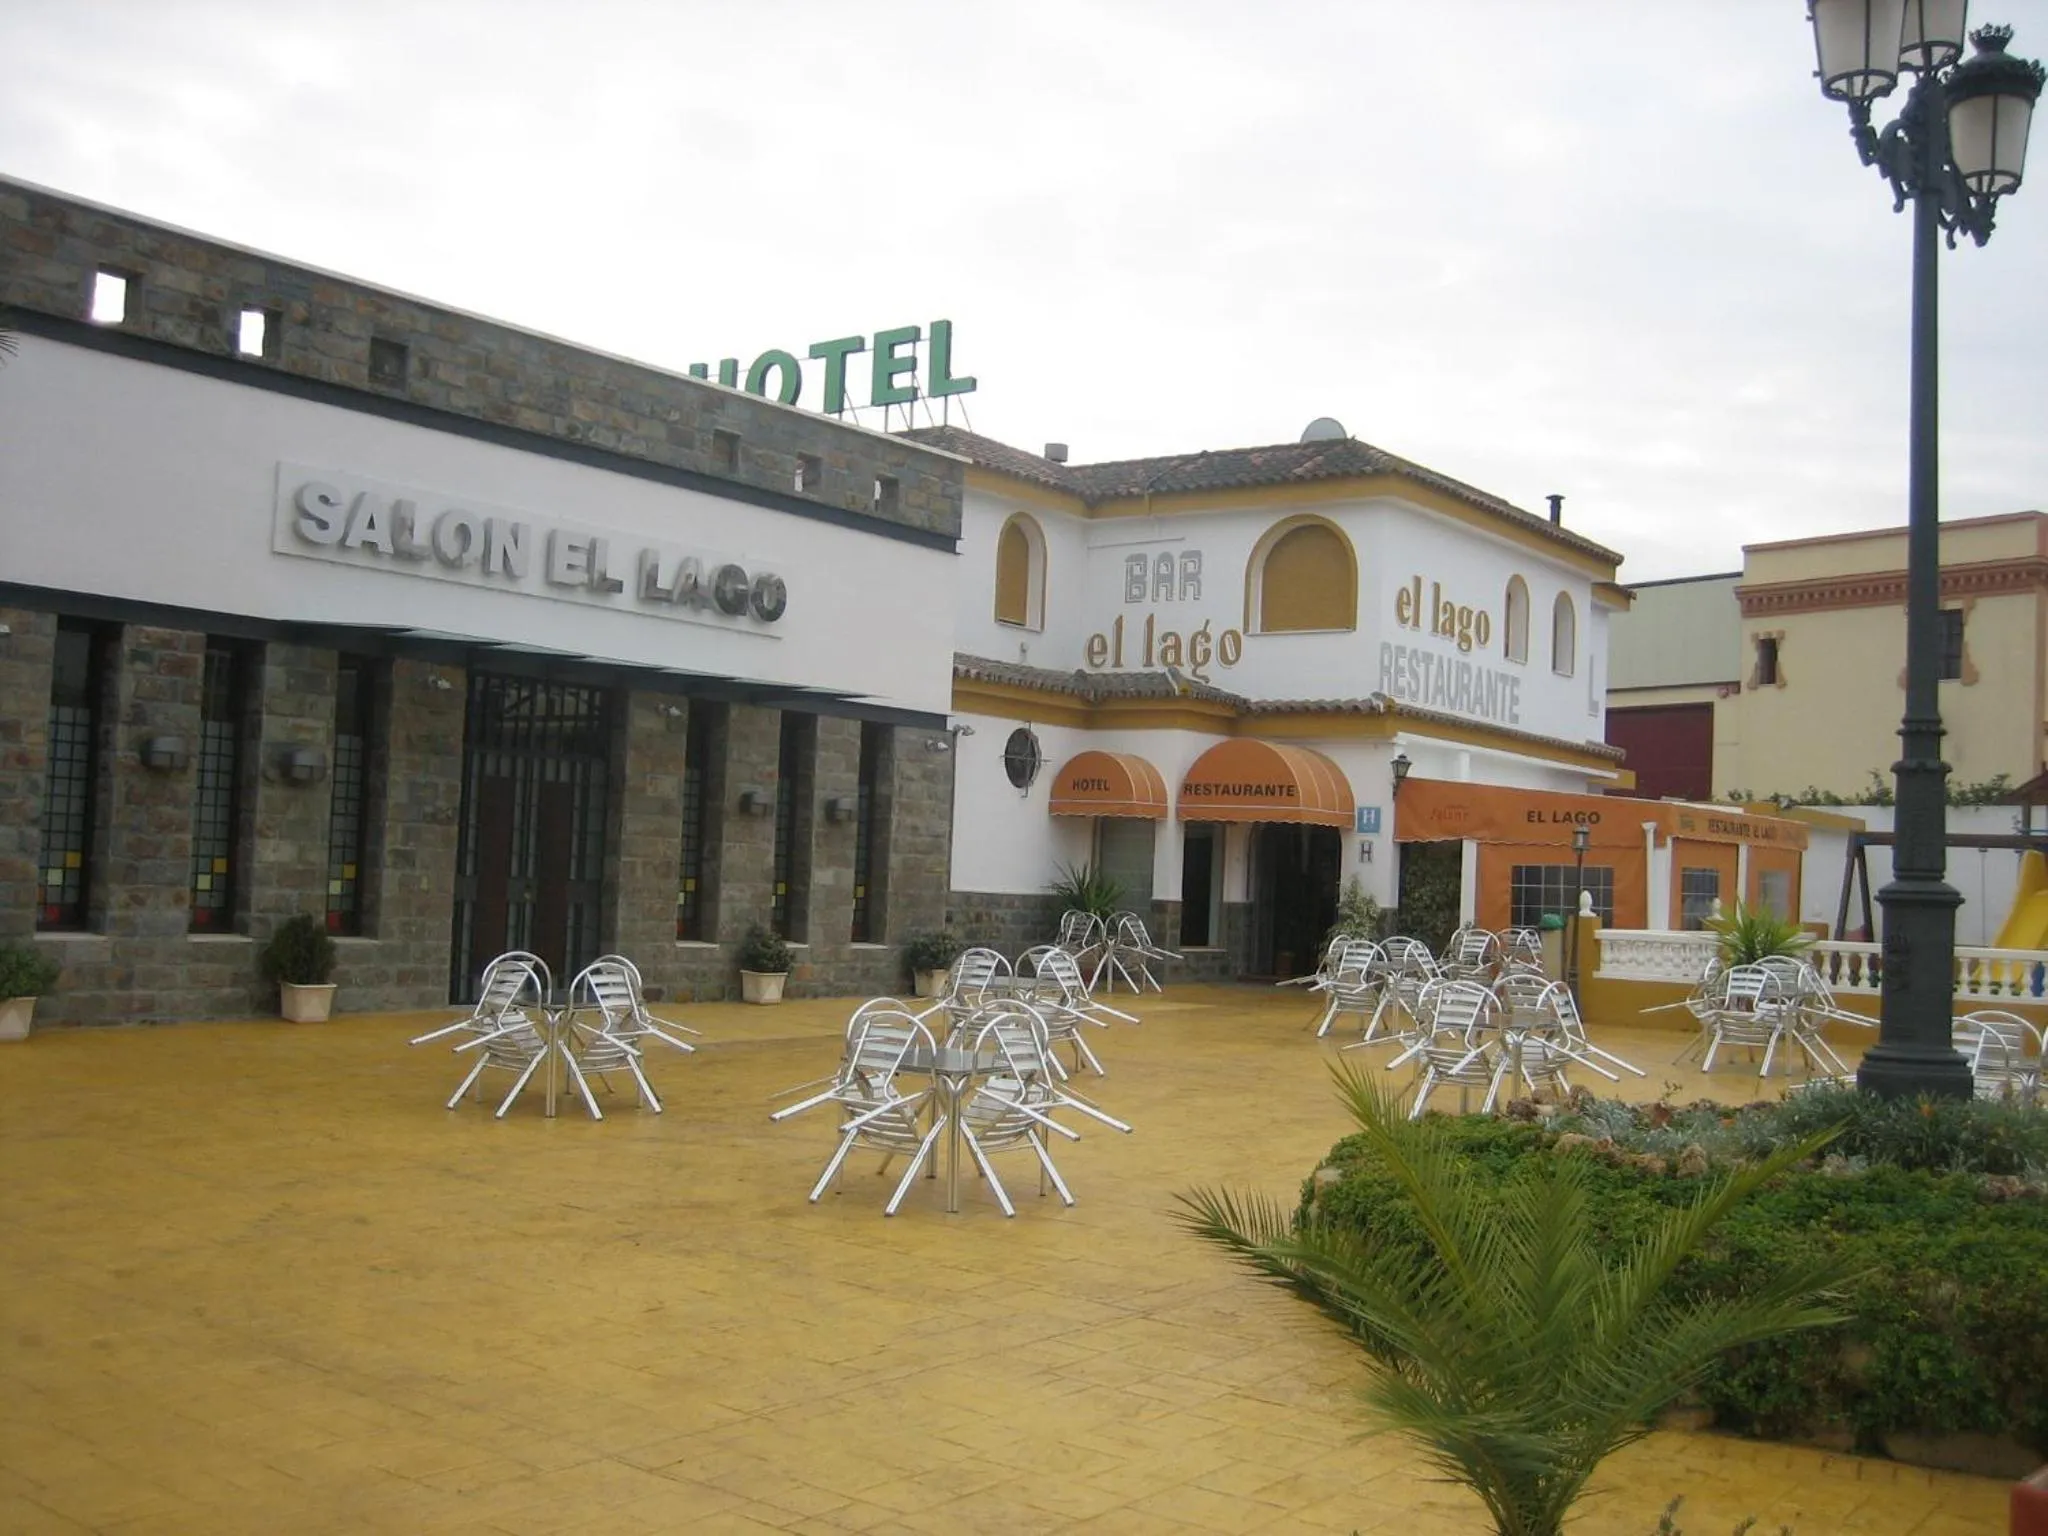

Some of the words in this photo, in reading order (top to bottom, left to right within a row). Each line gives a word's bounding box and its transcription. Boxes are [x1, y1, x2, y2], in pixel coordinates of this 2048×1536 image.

[294, 481, 532, 578] SALON
[546, 528, 624, 593] EL
[637, 548, 787, 622] LAGO
[1125, 550, 1202, 604] BAR
[1396, 575, 1421, 629] el
[1431, 581, 1490, 652] lago
[1087, 615, 1124, 668] el
[1143, 613, 1242, 683] lago
[1379, 642, 1521, 724] RESTAURANTE
[1072, 778, 1110, 793] HOTEL
[1183, 783, 1297, 797] RESTAURANTE
[1526, 810, 1546, 824] EL
[1552, 811, 1601, 825] LAGO
